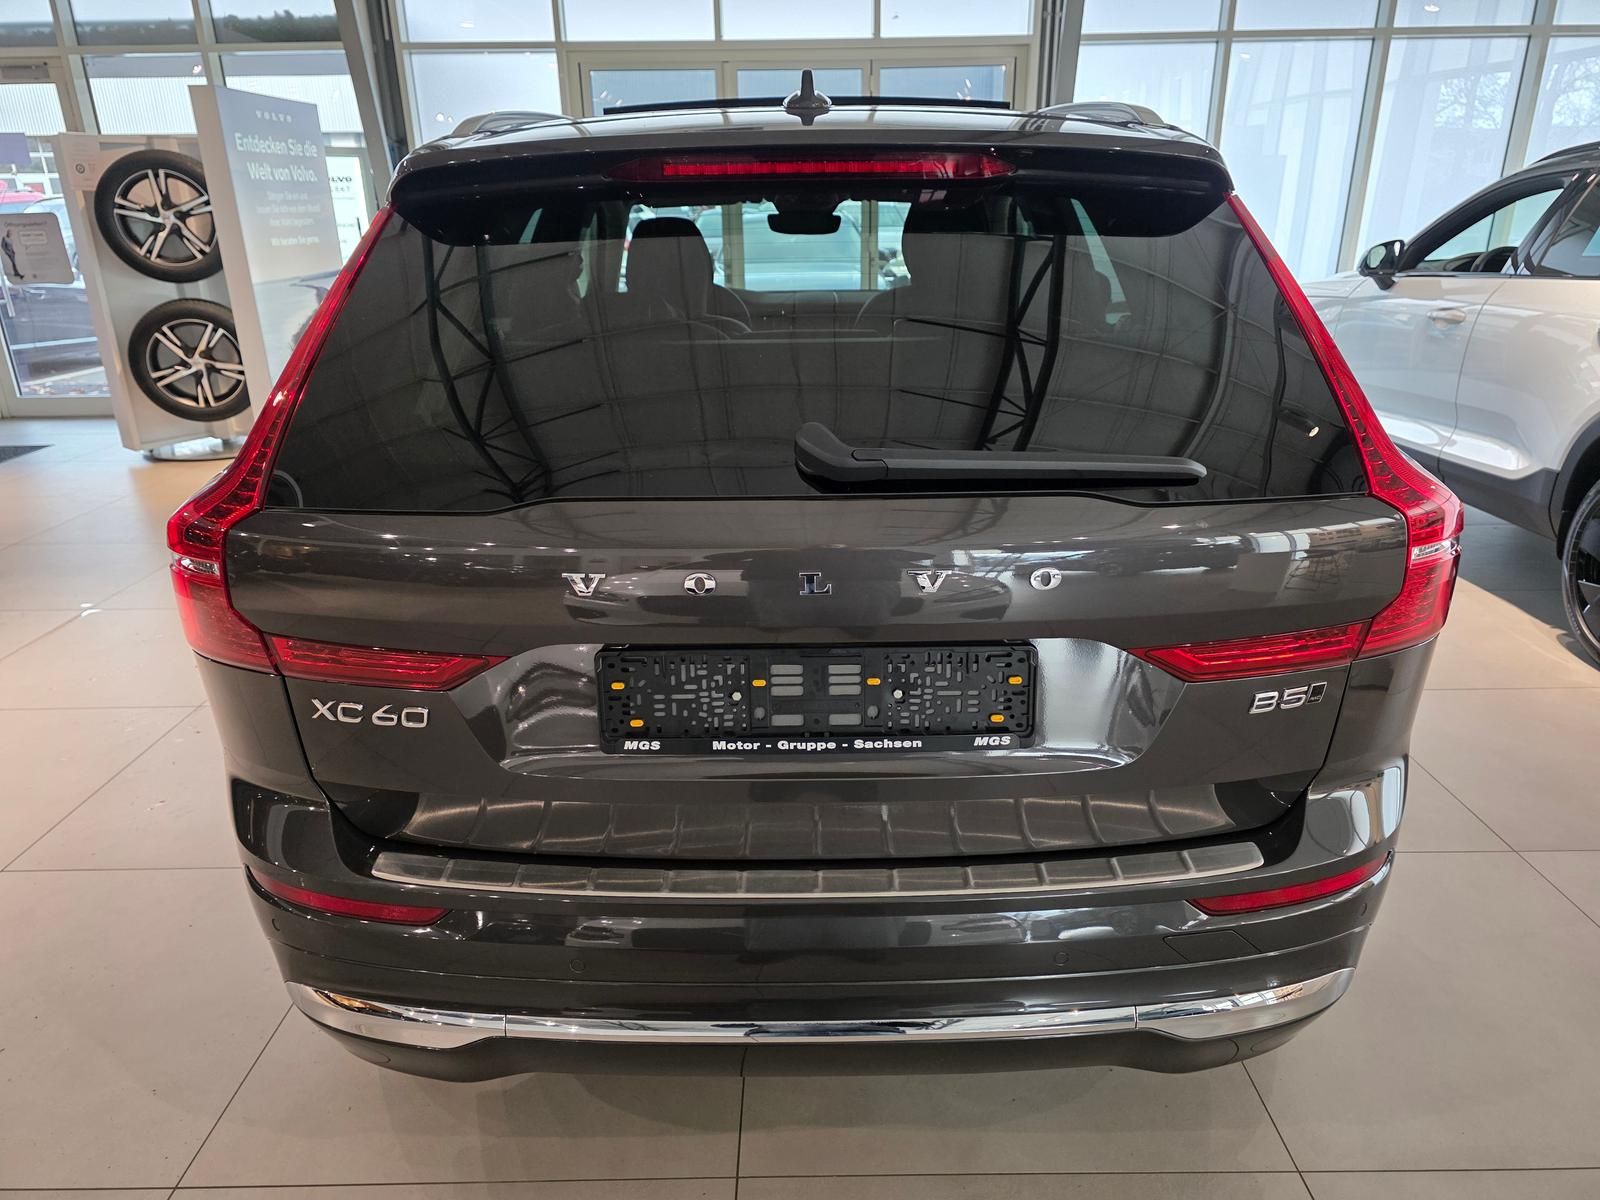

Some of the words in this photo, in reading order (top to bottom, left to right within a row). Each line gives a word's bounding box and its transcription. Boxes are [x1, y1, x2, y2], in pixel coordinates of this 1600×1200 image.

[256, 109, 292, 123] VOLVO
[234, 132, 288, 154] Entdecken
[288, 138, 304, 156] Sie
[304, 140, 318, 157] die
[247, 161, 273, 180] Welt
[273, 167, 290, 181] von
[290, 164, 318, 182] Volvo.
[561, 567, 1063, 597] VOLVO
[1249, 686, 1309, 714] B5
[311, 698, 364, 724] XC
[371, 704, 429, 729] 60
[623, 740, 661, 751] MGS
[712, 740, 761, 751] Motor
[777, 740, 837, 752] Gruppe
[853, 738, 923, 750] Sachsen
[973, 735, 1012, 747] MGS
